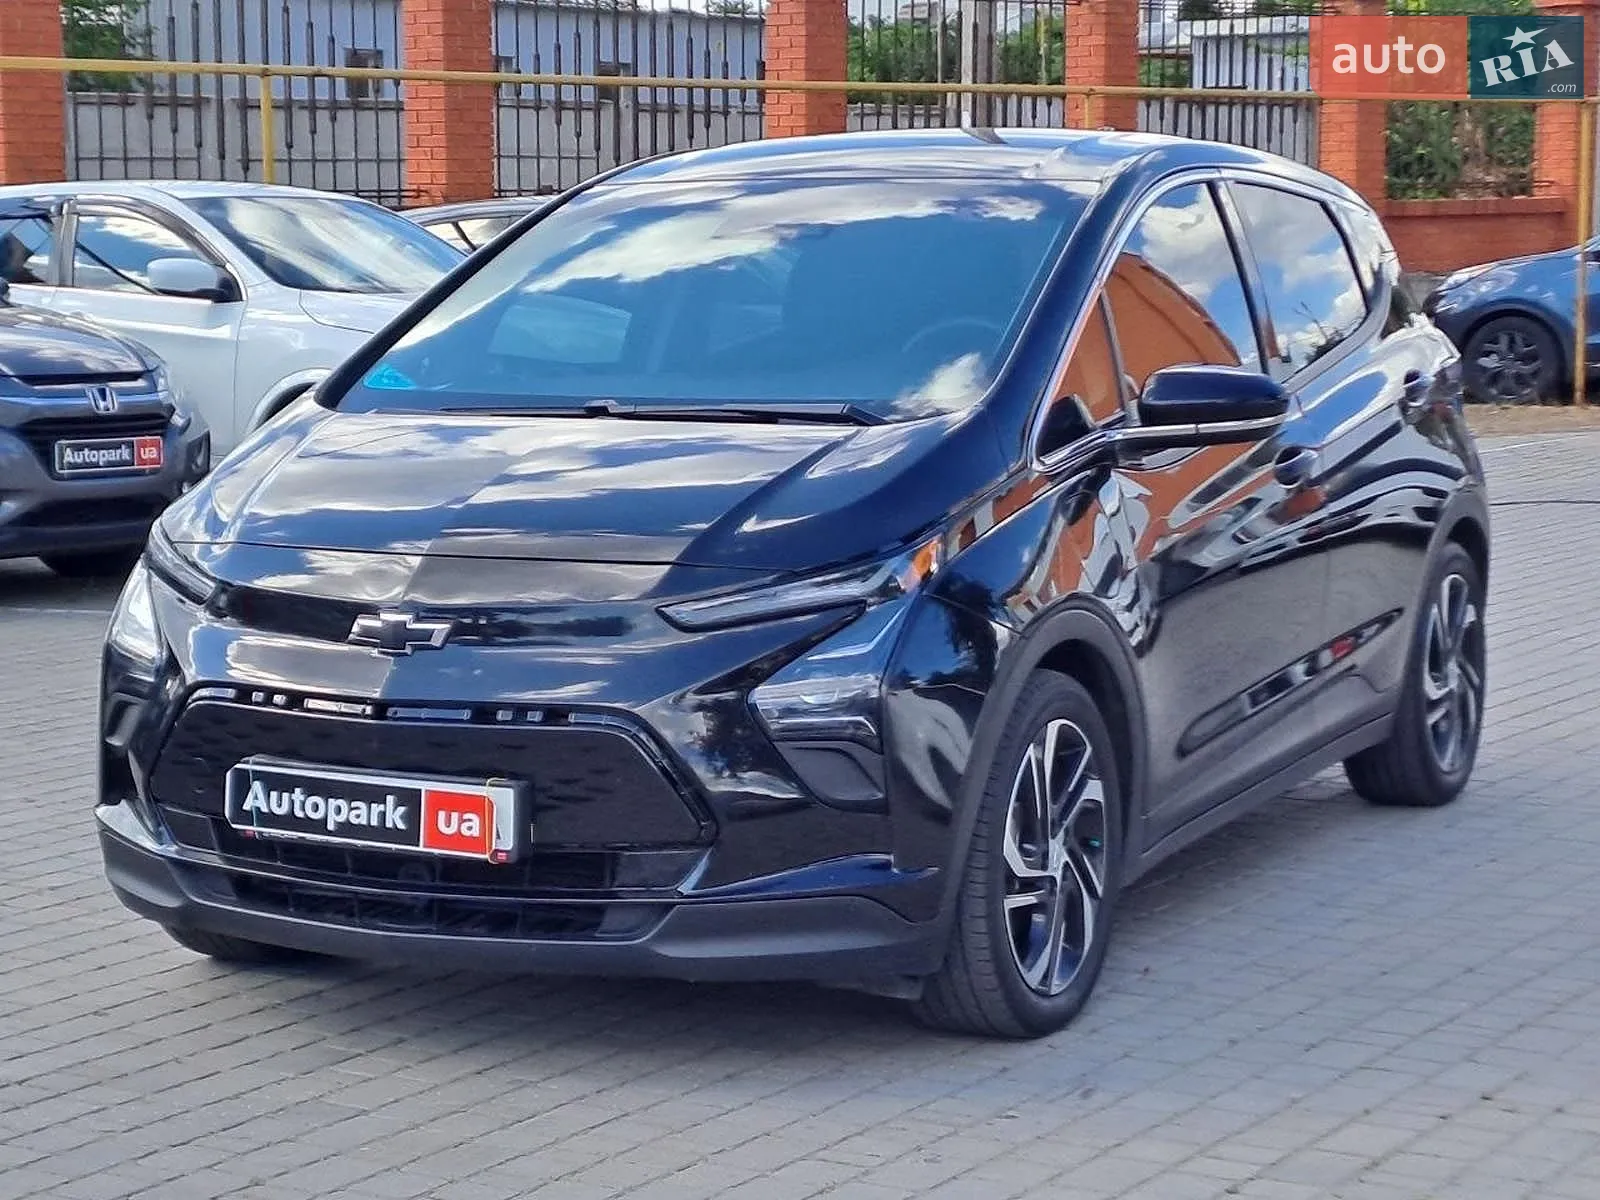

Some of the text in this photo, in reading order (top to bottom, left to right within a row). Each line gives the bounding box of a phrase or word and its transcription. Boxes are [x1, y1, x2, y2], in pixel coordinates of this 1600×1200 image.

[64, 444, 158, 465] Autopark ua
[242, 780, 407, 831] Autopark
[436, 808, 481, 837] ua
